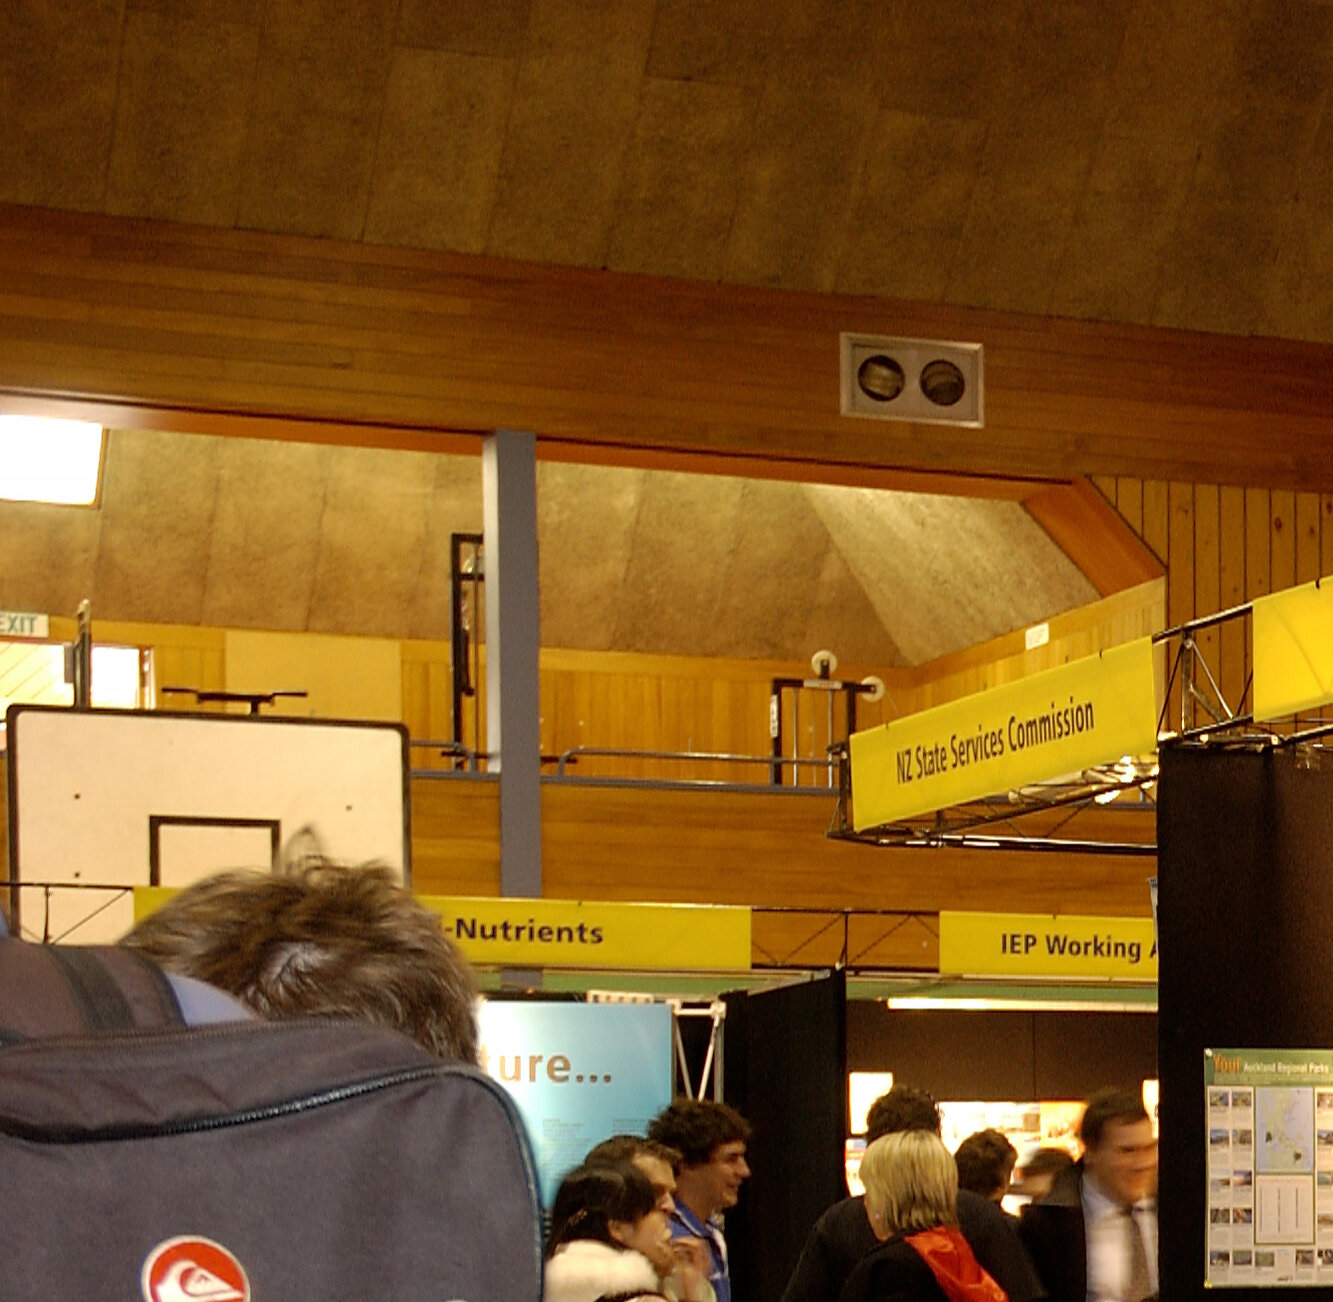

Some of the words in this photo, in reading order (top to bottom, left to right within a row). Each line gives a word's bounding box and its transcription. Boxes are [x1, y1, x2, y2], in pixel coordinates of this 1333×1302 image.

[896, 748, 914, 785] NZ
[916, 742, 947, 779] State
[950, 724, 1005, 769] Services
[1008, 696, 1095, 752] Commission
[1001, 932, 1037, 954] IEP
[1045, 933, 1142, 964] Working
